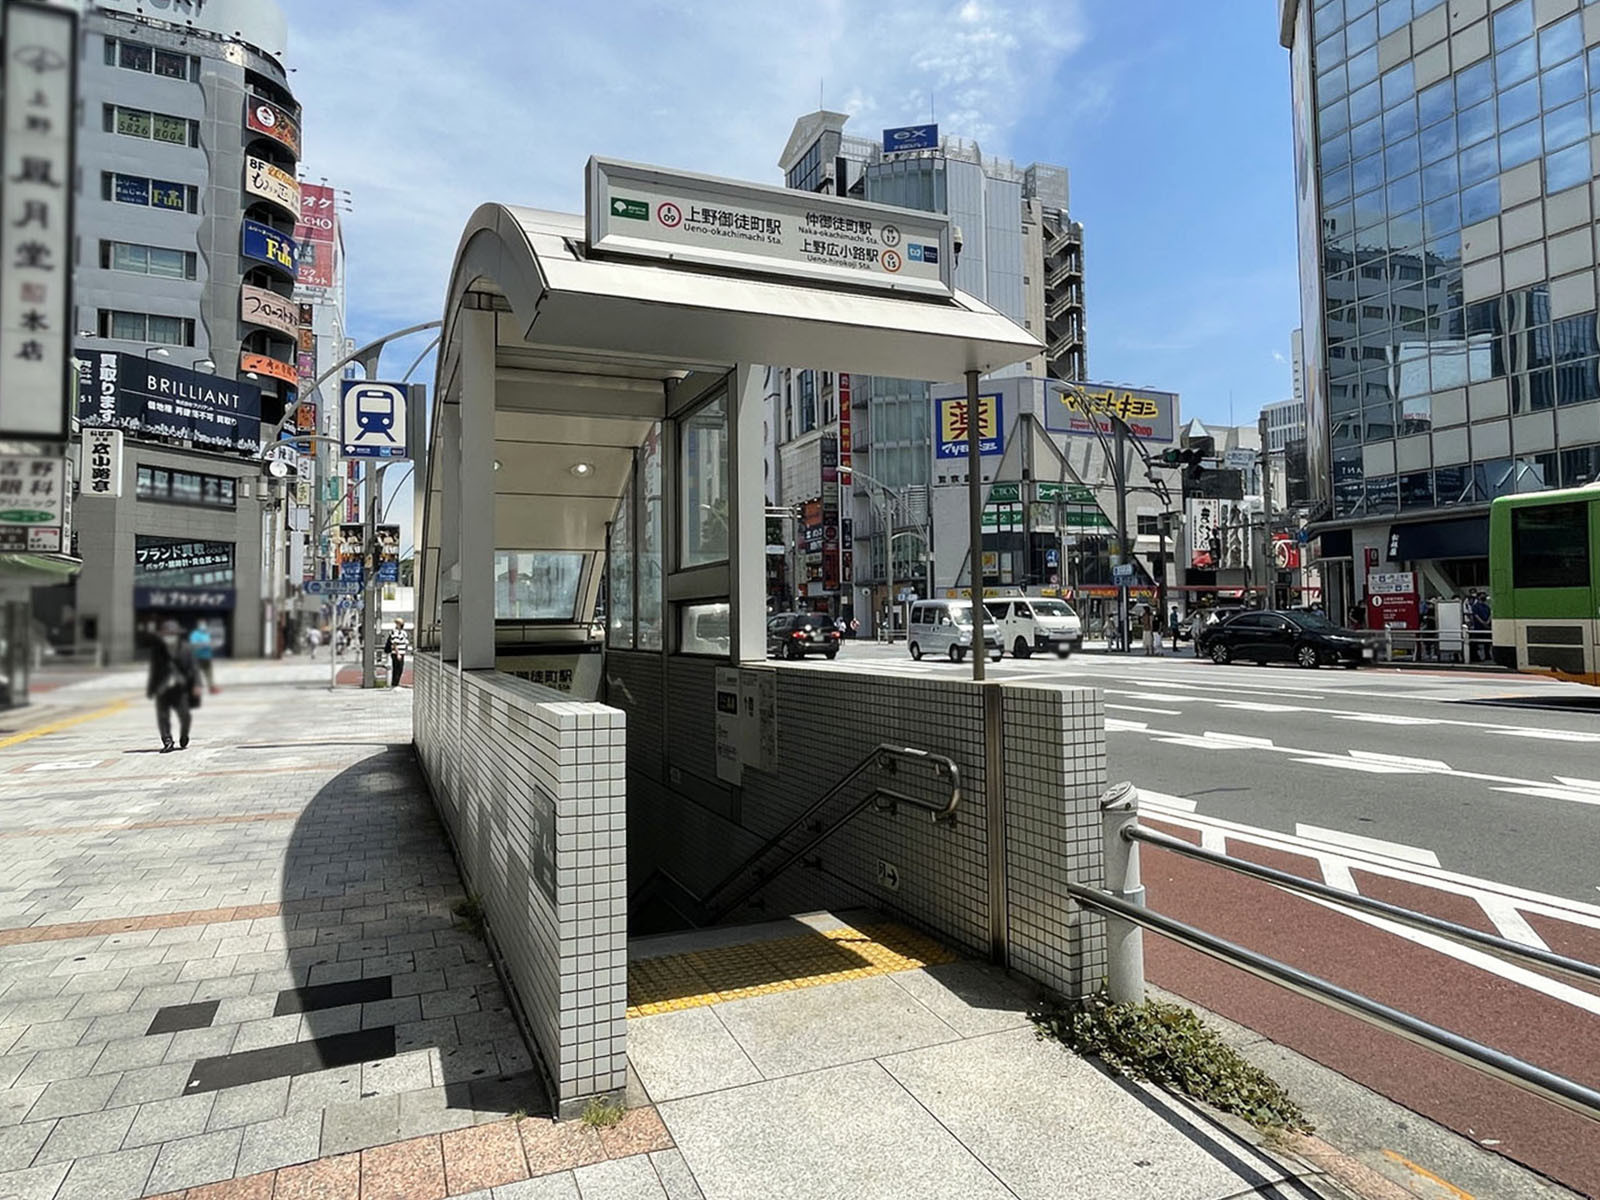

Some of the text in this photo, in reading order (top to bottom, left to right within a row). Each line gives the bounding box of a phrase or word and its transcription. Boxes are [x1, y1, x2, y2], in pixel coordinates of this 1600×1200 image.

[119, 121, 148, 136] 5826
[249, 158, 266, 171] 8F
[152, 189, 182, 207] Fun
[663, 214, 676, 223] 09
[685, 206, 782, 235] 上野御徒町駅
[805, 212, 872, 236] 仲御徒町駅
[684, 223, 783, 245] Ueno-okachimachi Sta.
[798, 226, 879, 245] Naka-okachimachi Sta.
[886, 235, 896, 243] 17
[265, 238, 293, 269] Fun
[800, 239, 879, 263] 上野広小路駅
[807, 255, 857, 269] Ueno-hirokoji
[886, 260, 897, 268] 15
[99, 353, 117, 423] 買取ります
[147, 375, 240, 409] BRILLIANT
[949, 400, 989, 440] 薬
[136, 543, 206, 562] ブランド買取
